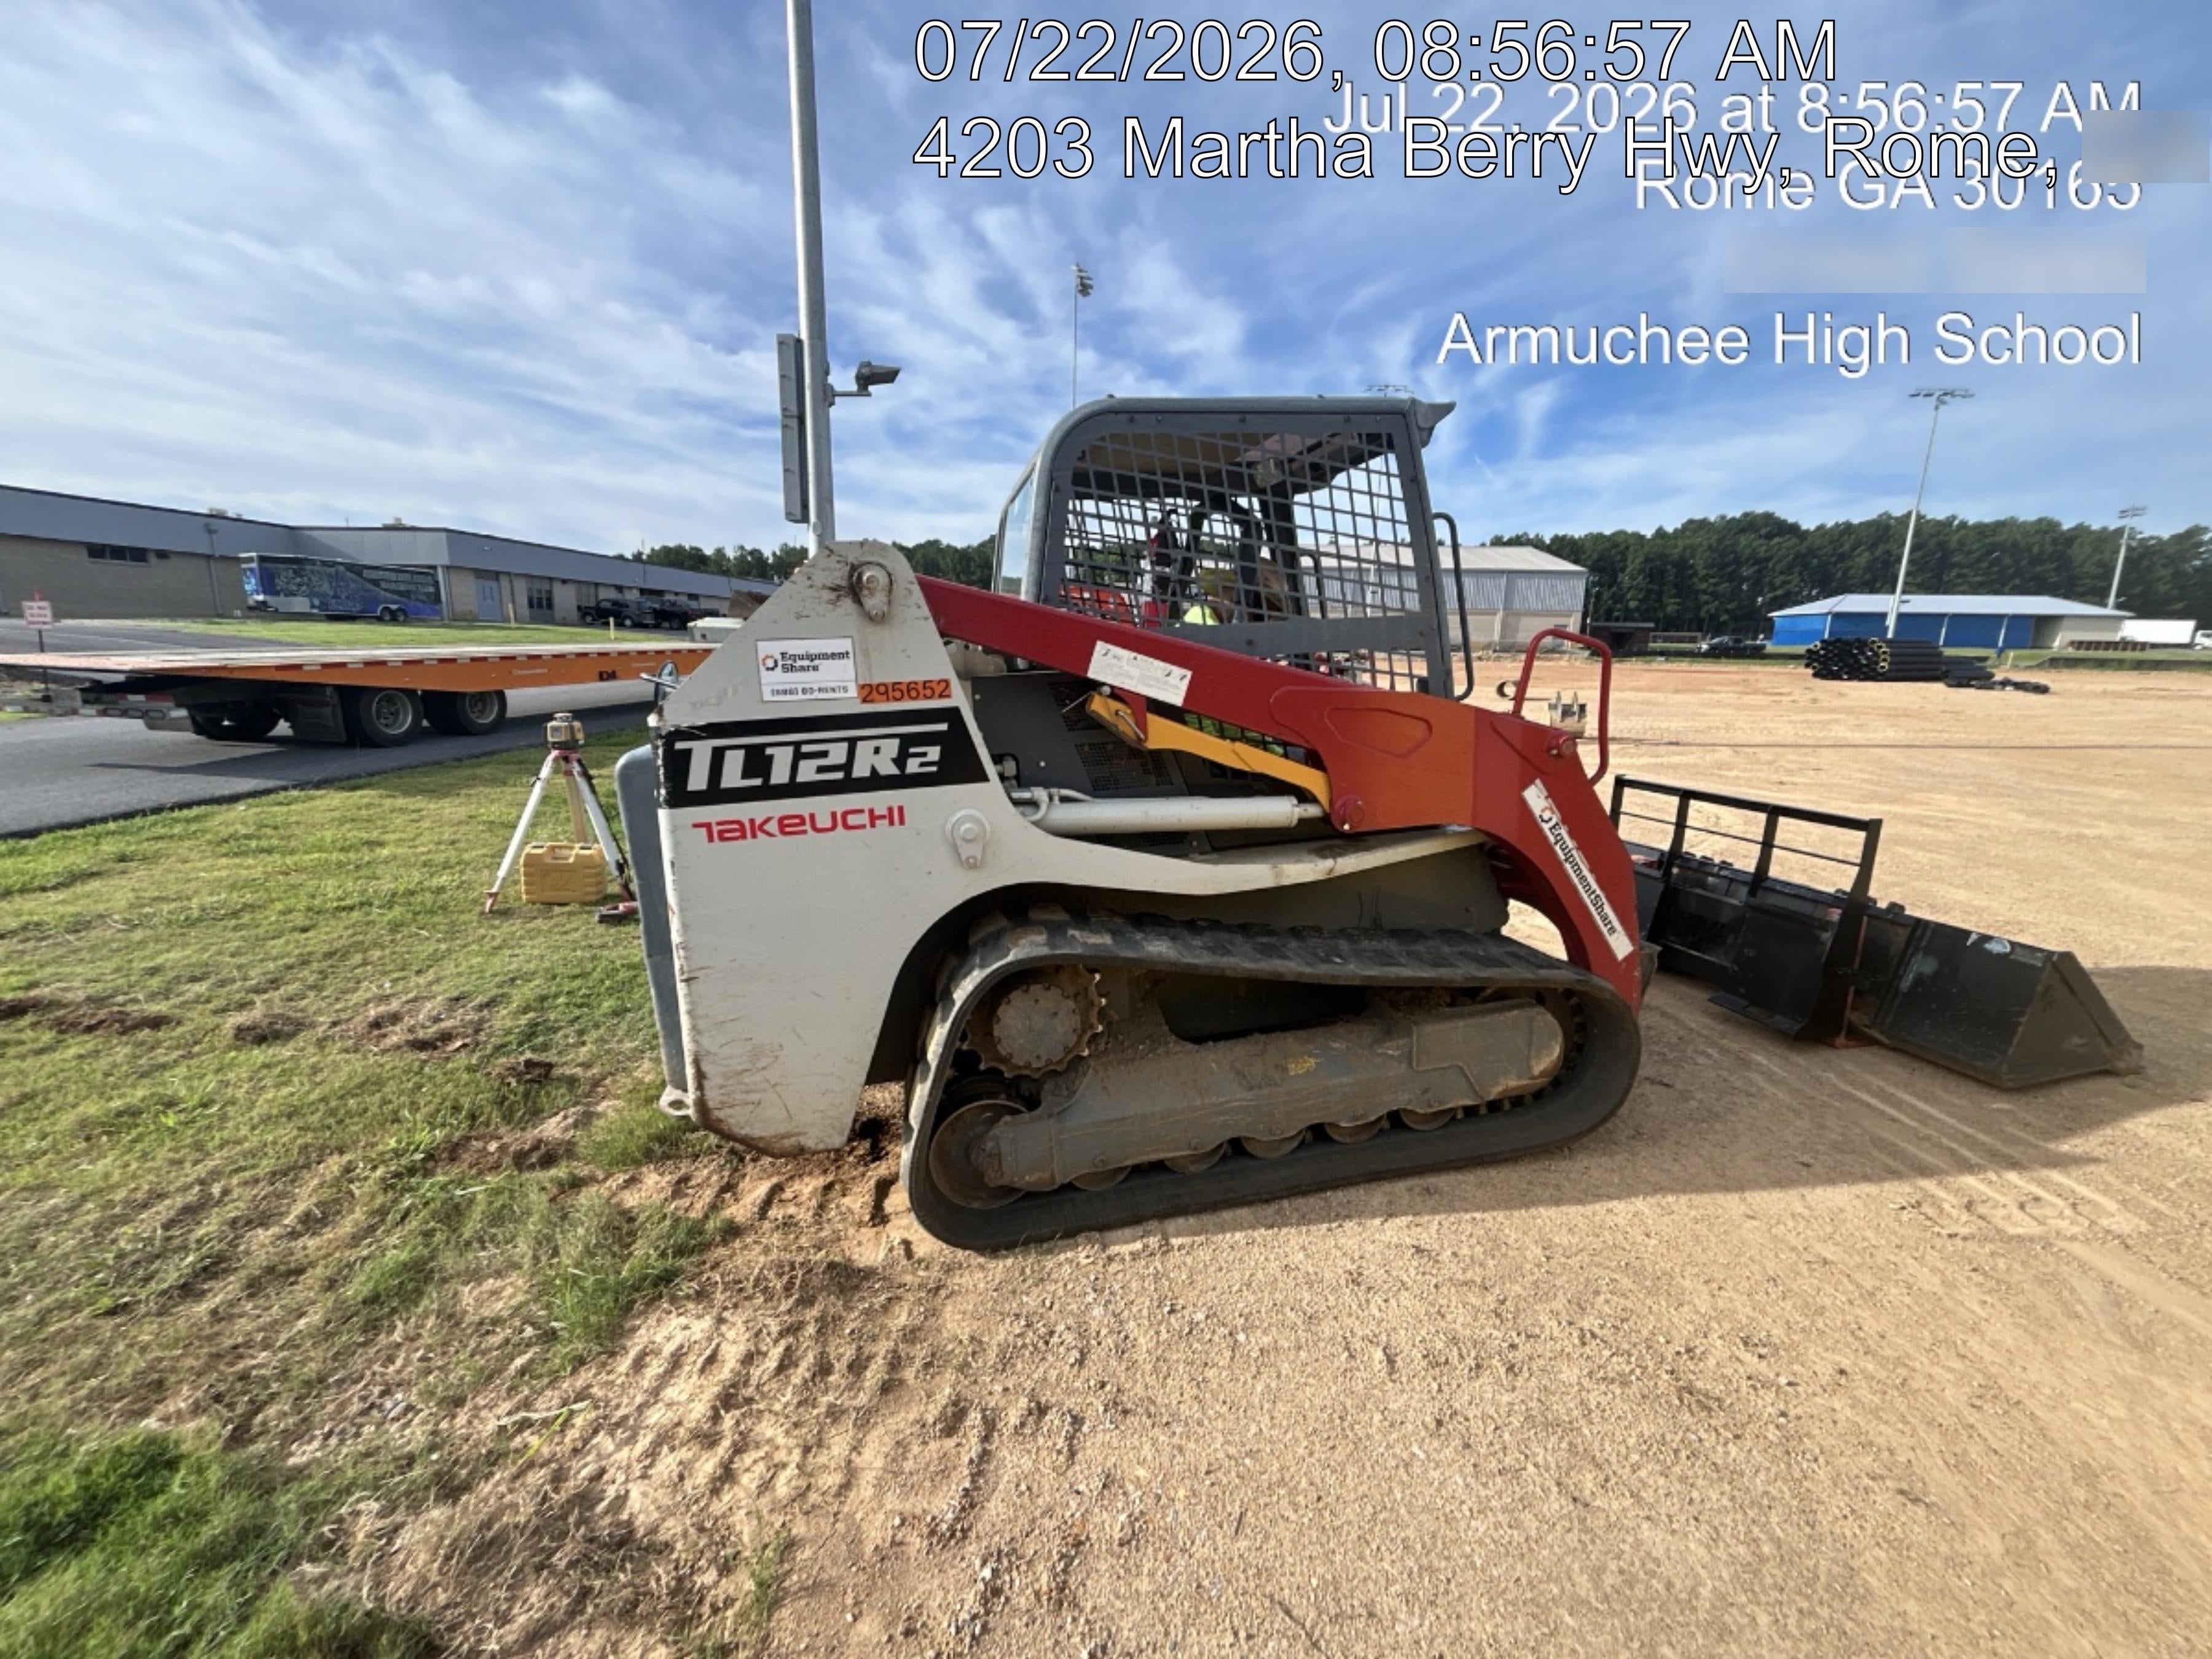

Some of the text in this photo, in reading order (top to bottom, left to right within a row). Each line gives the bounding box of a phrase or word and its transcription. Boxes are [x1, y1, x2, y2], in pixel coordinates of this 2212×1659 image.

[780, 650, 850, 662] Equipment
[781, 663, 819, 673] Share
[861, 680, 951, 704] 295652
[1549, 822, 1617, 936] EquipmentShare
